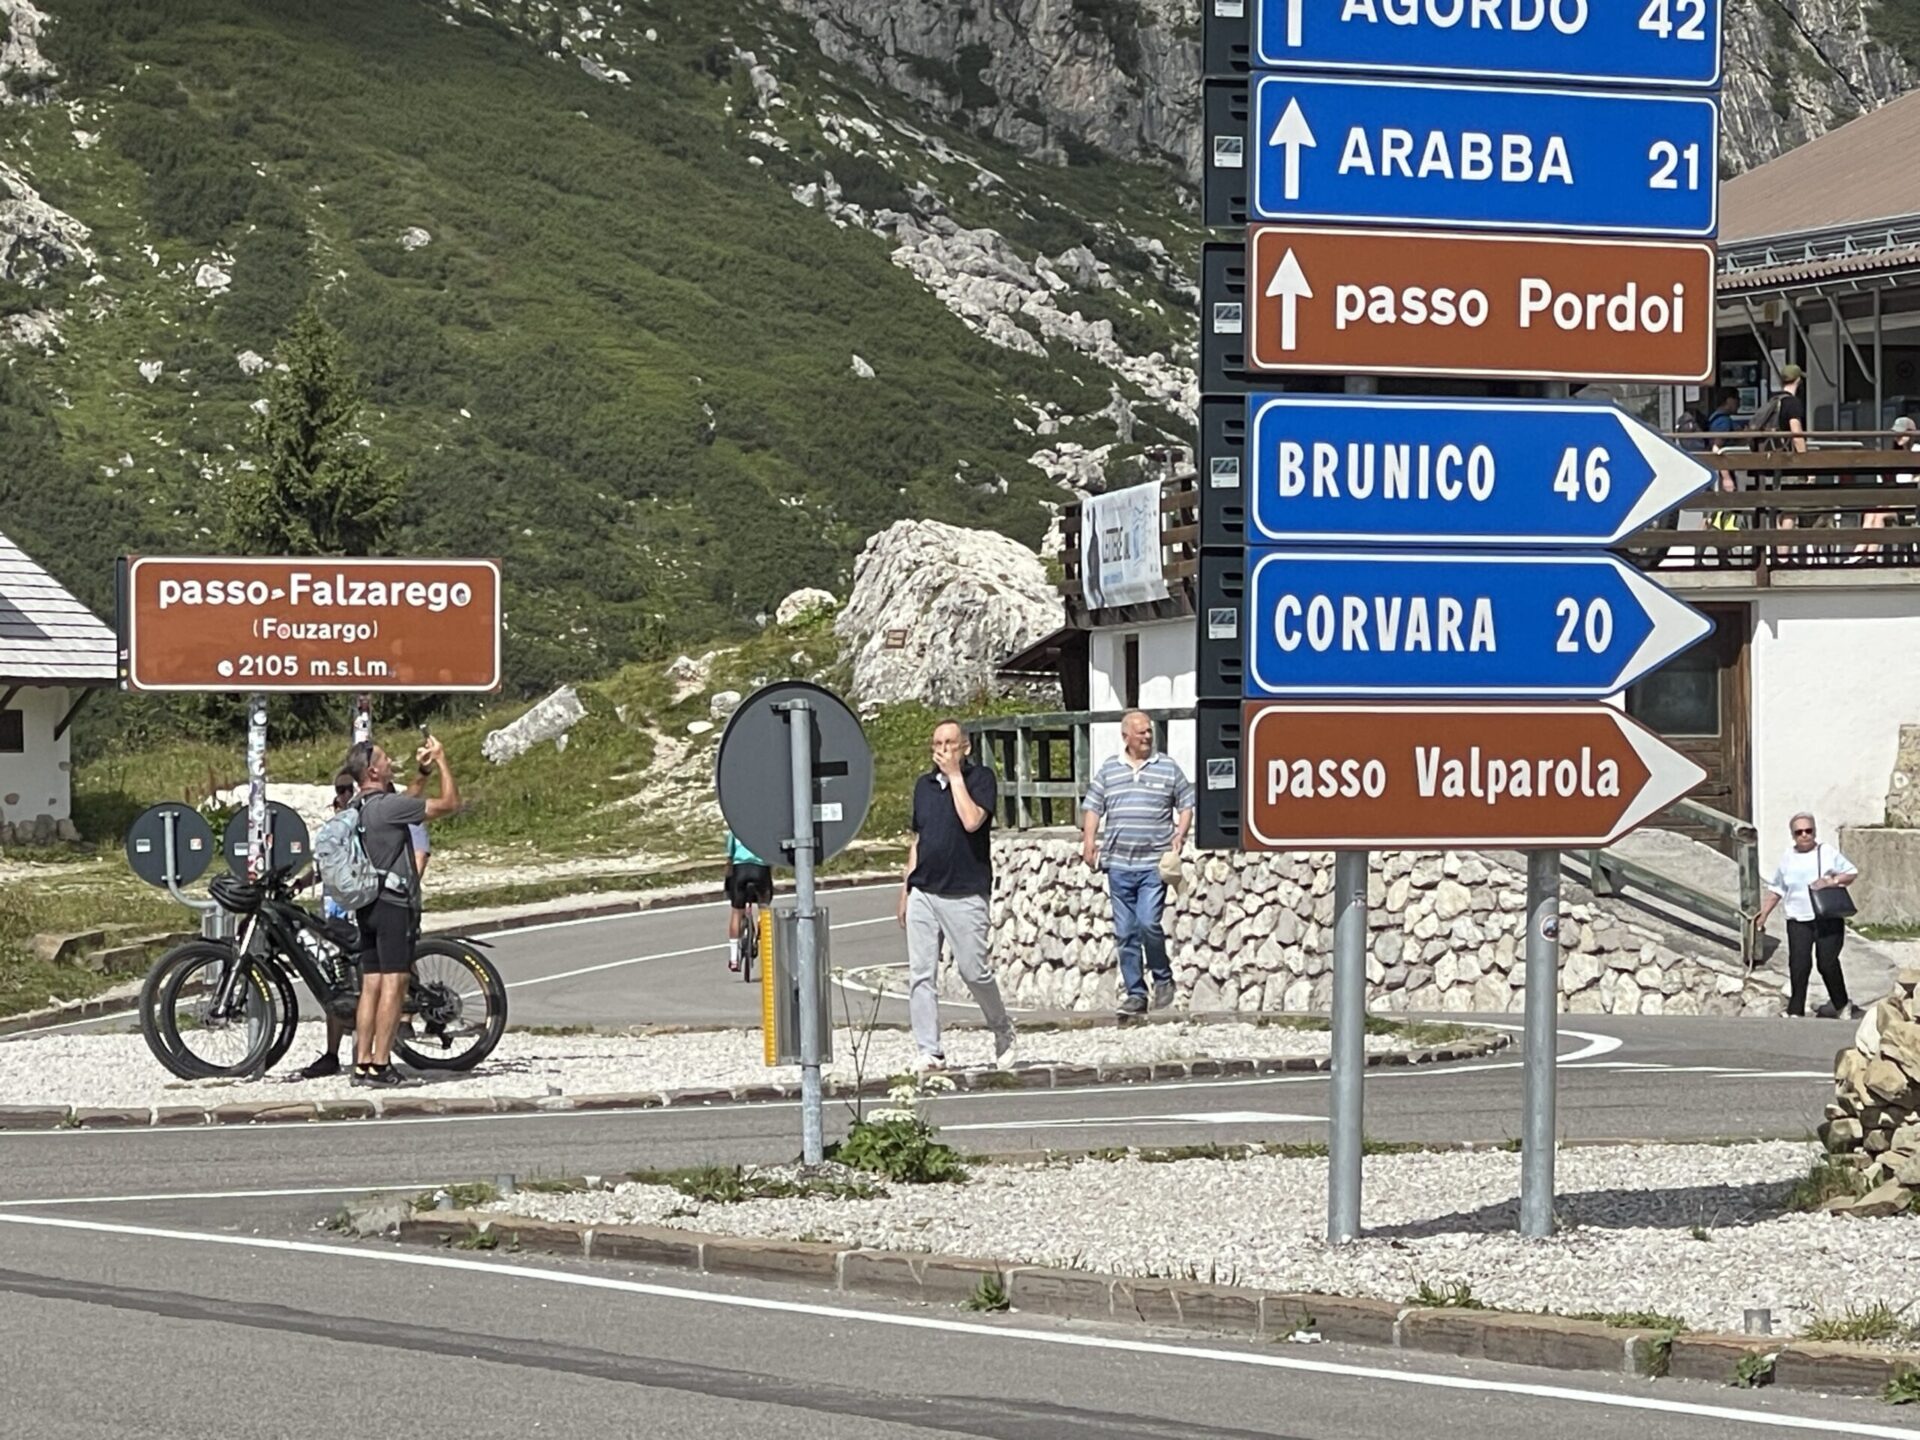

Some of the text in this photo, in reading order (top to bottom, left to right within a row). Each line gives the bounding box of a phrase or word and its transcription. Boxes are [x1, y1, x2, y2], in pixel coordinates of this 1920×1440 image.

[1638, 0, 1706, 40] 42
[1338, 127, 1699, 190] ARABBA 21
[1335, 278, 1685, 334] passo Pordoi
[1278, 442, 1611, 503] BRUNICO 46
[1273, 594, 1614, 653] CORVARA 20
[238, 655, 299, 677] 2105
[1267, 746, 1620, 805] passo Valparola
